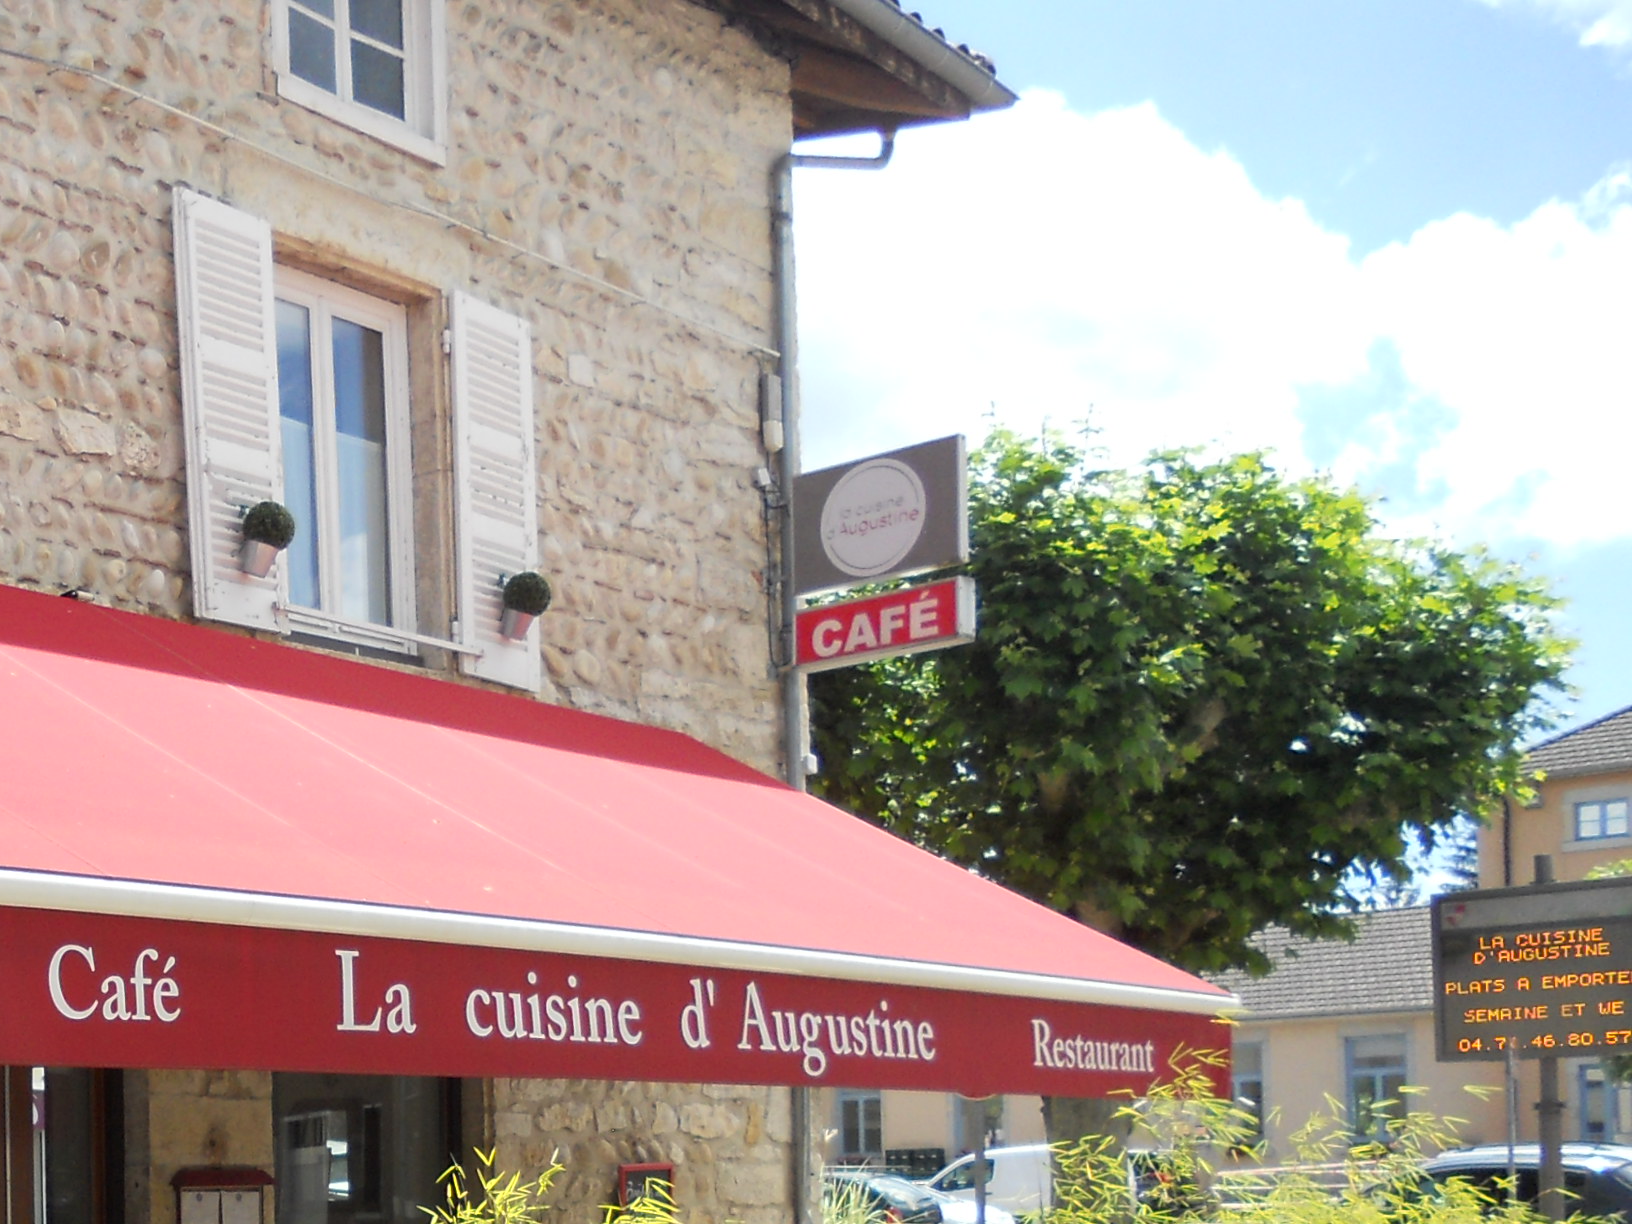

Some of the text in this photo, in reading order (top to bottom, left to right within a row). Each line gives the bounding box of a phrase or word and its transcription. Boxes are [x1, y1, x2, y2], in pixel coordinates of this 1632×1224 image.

[839, 508, 920, 537] Augustine
[811, 590, 939, 658] CAFÉ
[1478, 927, 1604, 951] LA CUISINE
[1472, 942, 1611, 966] D'AUGUSTINE
[47, 944, 182, 1023] Café
[1444, 969, 1632, 996] PLATS A EMPORTE
[334, 949, 418, 1035] La
[466, 972, 644, 1046] cuisine
[737, 980, 937, 1077] Augustine
[1463, 1000, 1625, 1024] SEMAINE ET WE
[1030, 1018, 1156, 1073] Restaurant
